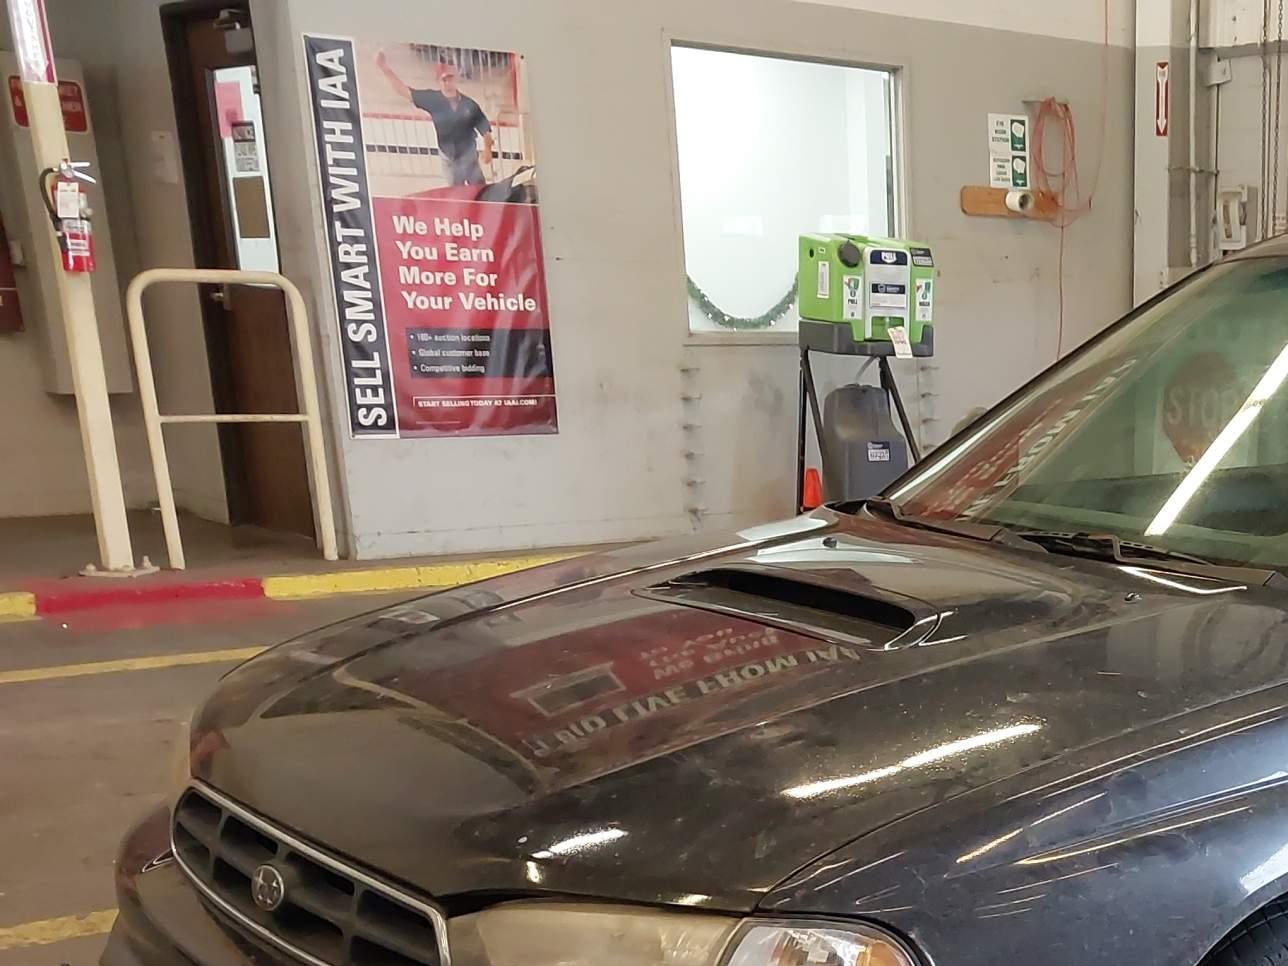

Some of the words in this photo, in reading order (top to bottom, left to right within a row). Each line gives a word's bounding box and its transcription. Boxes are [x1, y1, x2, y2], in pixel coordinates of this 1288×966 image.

[316, 48, 351, 109] IAA
[323, 121, 362, 213] WITH
[392, 216, 427, 236] We
[434, 218, 484, 241] Help
[396, 241, 437, 261] You
[445, 243, 494, 262] Earn
[335, 221, 378, 343] SMART
[399, 266, 456, 285] More
[463, 268, 498, 286] For
[400, 291, 453, 309] Your
[459, 293, 537, 311] Vehicle
[418, 348, 440, 357] Global
[442, 349, 473, 357] customer
[474, 349, 490, 357] base
[420, 364, 460, 373] Competitive
[461, 364, 485, 373] bidding
[351, 352, 388, 426] SELL
[418, 400, 440, 408] START
[441, 400, 469, 408] SELLING
[470, 400, 493, 408] TODAY
